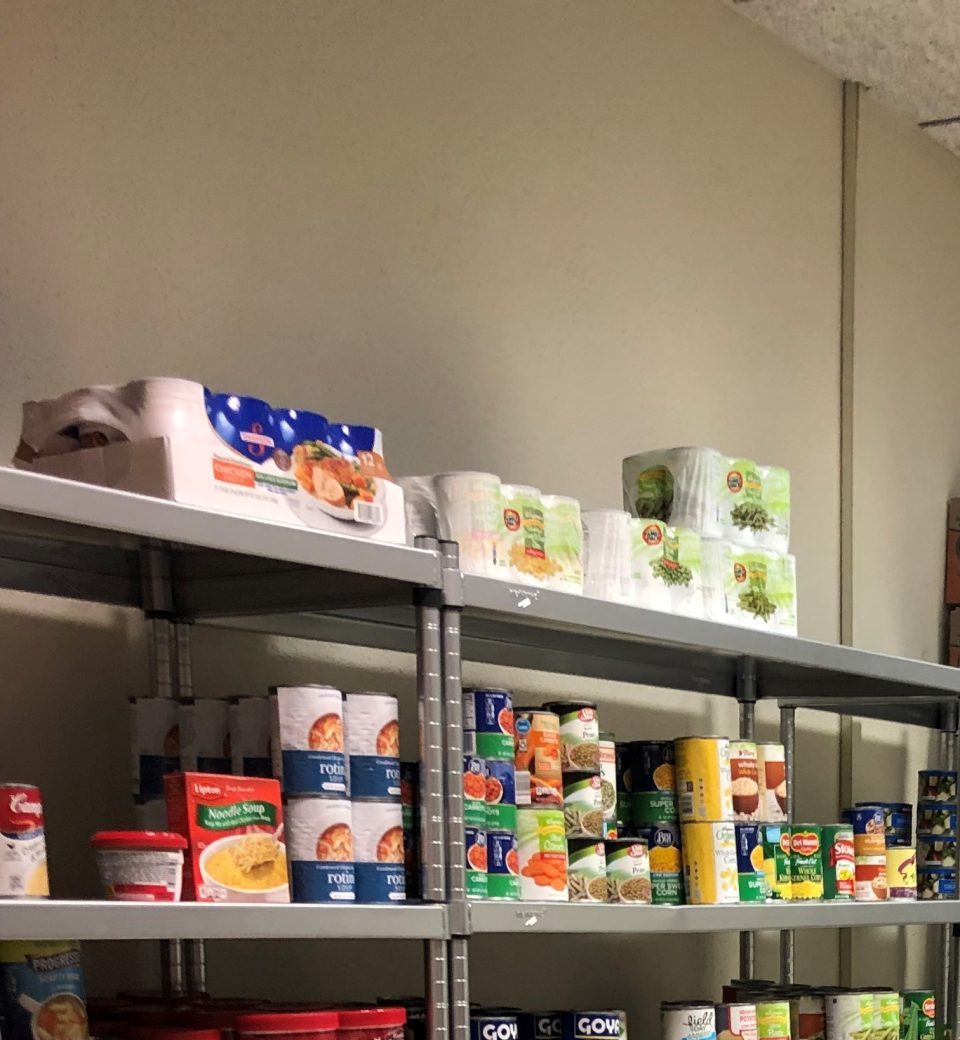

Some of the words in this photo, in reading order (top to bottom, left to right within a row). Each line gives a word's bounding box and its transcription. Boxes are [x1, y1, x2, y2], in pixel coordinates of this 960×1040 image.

[194, 784, 222, 796] Lipton
[208, 804, 241, 820] Noodle
[242, 802, 266, 815] Soup
